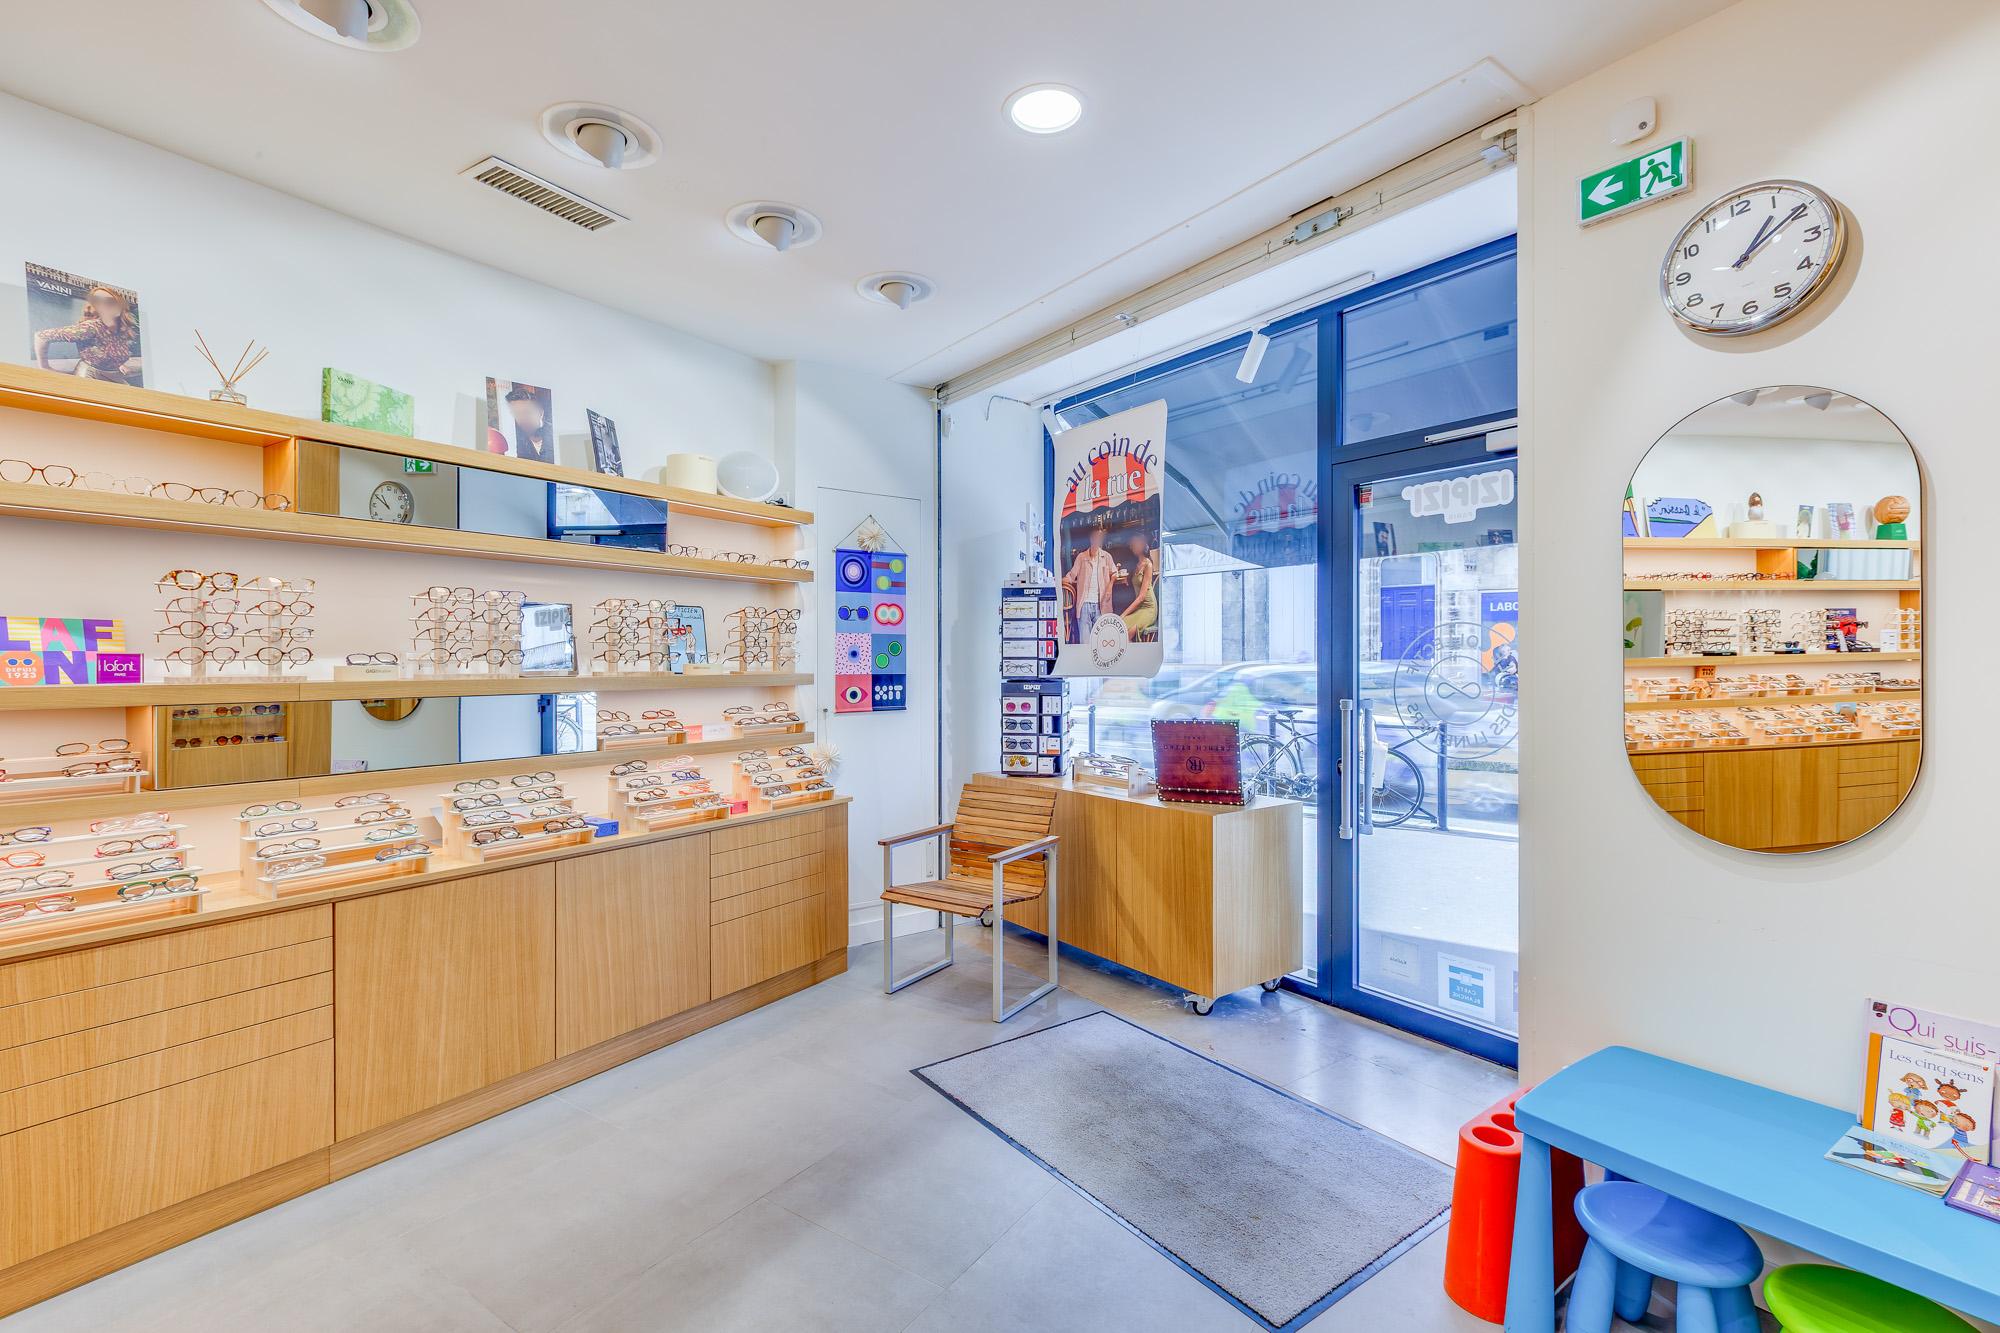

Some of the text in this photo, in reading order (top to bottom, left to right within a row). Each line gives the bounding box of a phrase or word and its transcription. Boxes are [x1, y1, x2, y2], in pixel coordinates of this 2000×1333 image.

[1729, 199, 1751, 218] 12
[1771, 195, 1777, 208] 1
[1803, 224, 1822, 243] 3
[1683, 243, 1700, 260] 10
[1796, 255, 1815, 271] 4
[36, 280, 72, 296] VANNI
[1675, 272, 1692, 287] 9
[1773, 282, 1792, 299] 5
[1686, 292, 1704, 308] 8
[1742, 300, 1759, 315] 6
[1710, 303, 1725, 319] 7
[1066, 432, 1158, 493] au coin de
[1082, 469, 1142, 502] la rue
[1100, 617, 1125, 634] COLLECTIF
[103, 659, 136, 672] lafont
[1888, 1007, 1936, 1039] Qui
[1943, 1035, 1996, 1056] suis-
[1889, 1049, 1912, 1064] Les
[1915, 1058, 1947, 1077] cinq
[1950, 1068, 1985, 1085] sens
